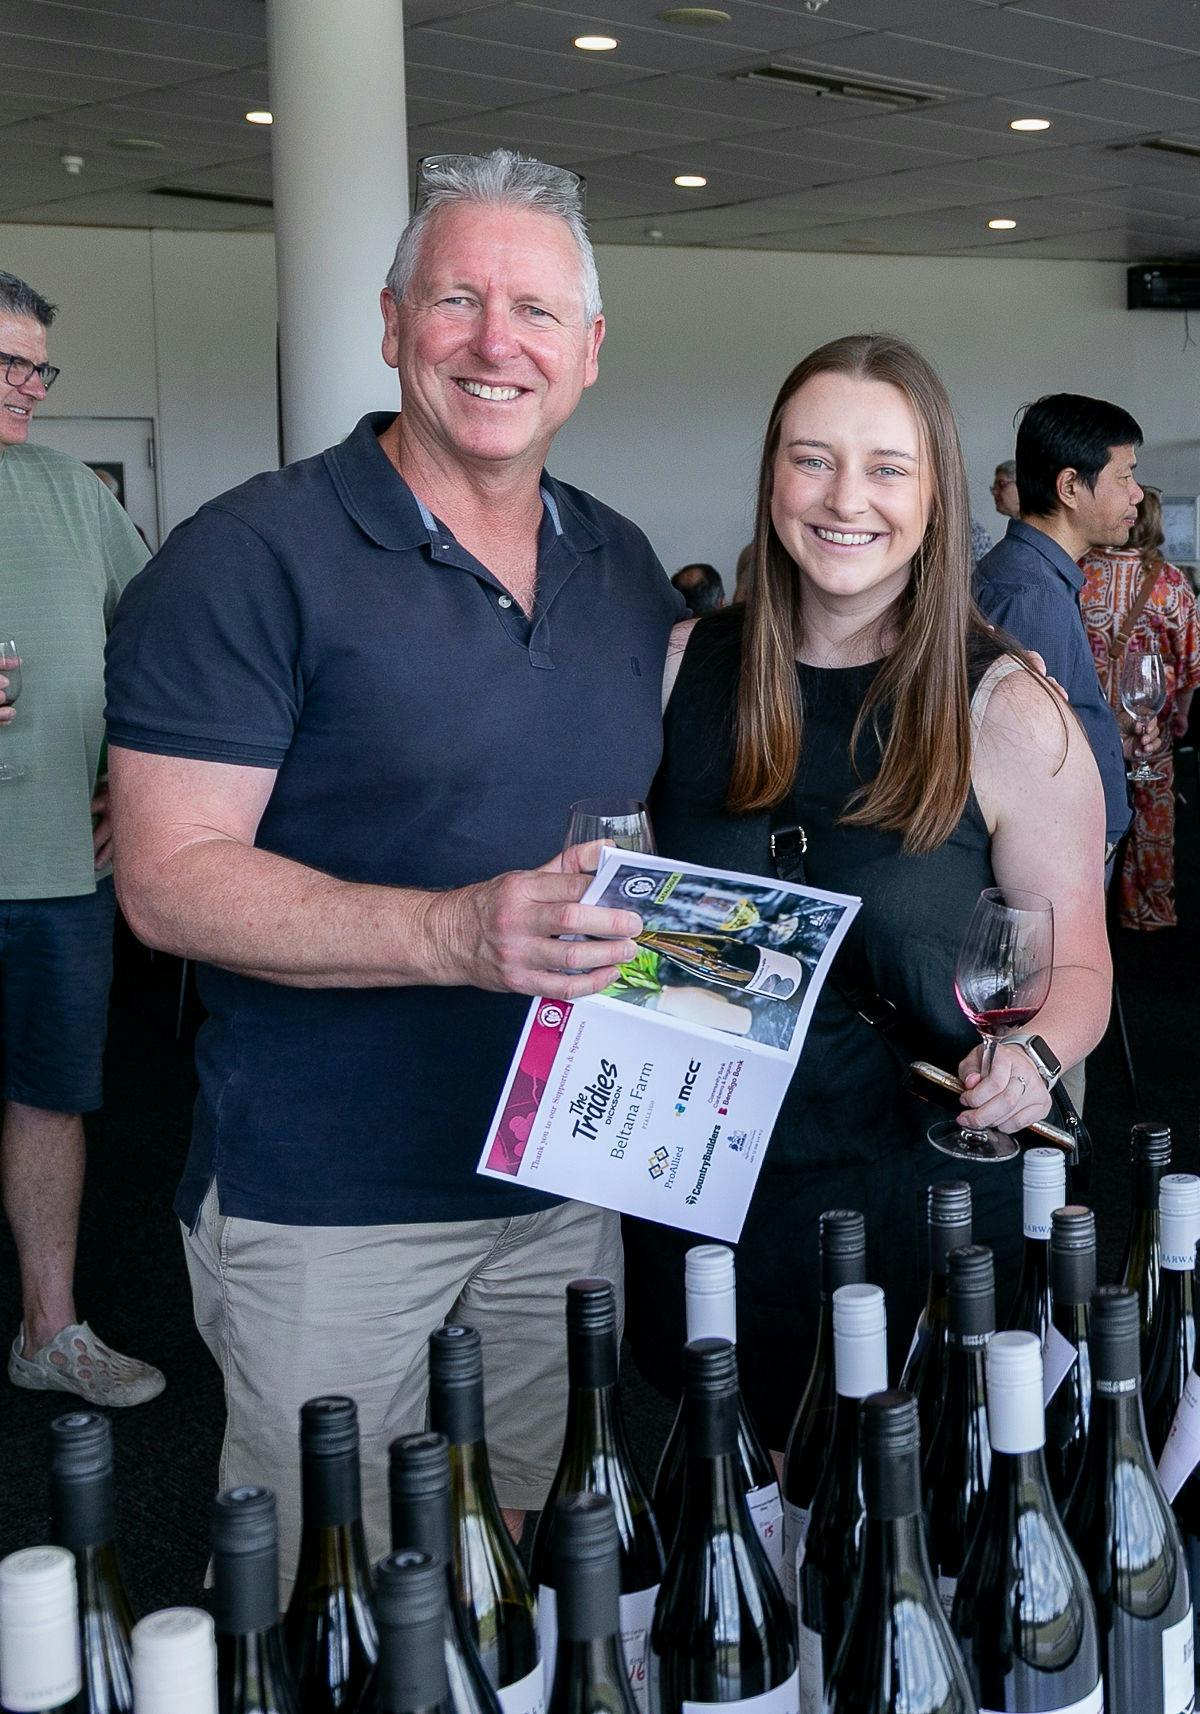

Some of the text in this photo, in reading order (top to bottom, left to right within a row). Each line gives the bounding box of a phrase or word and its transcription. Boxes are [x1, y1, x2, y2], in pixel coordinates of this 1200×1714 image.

[530, 1146, 545, 1171] Thank
[541, 1129, 550, 1146] you
[546, 1120, 553, 1130] to
[553, 1065, 571, 1105] Supporters
[571, 1020, 587, 1054] Sponsors
[571, 1058, 618, 1141] Tradies
[678, 1060, 702, 1102] mcc
[722, 1060, 745, 1106] Bendigo Bank
[568, 1092, 588, 1117] The
[605, 1085, 623, 1126] DICKSON
[610, 1062, 655, 1160] Beltana Farm
[664, 1146, 684, 1189] ProAllied
[692, 1124, 721, 1197] CountryBuilders
[764, 1524, 774, 1538] 15
